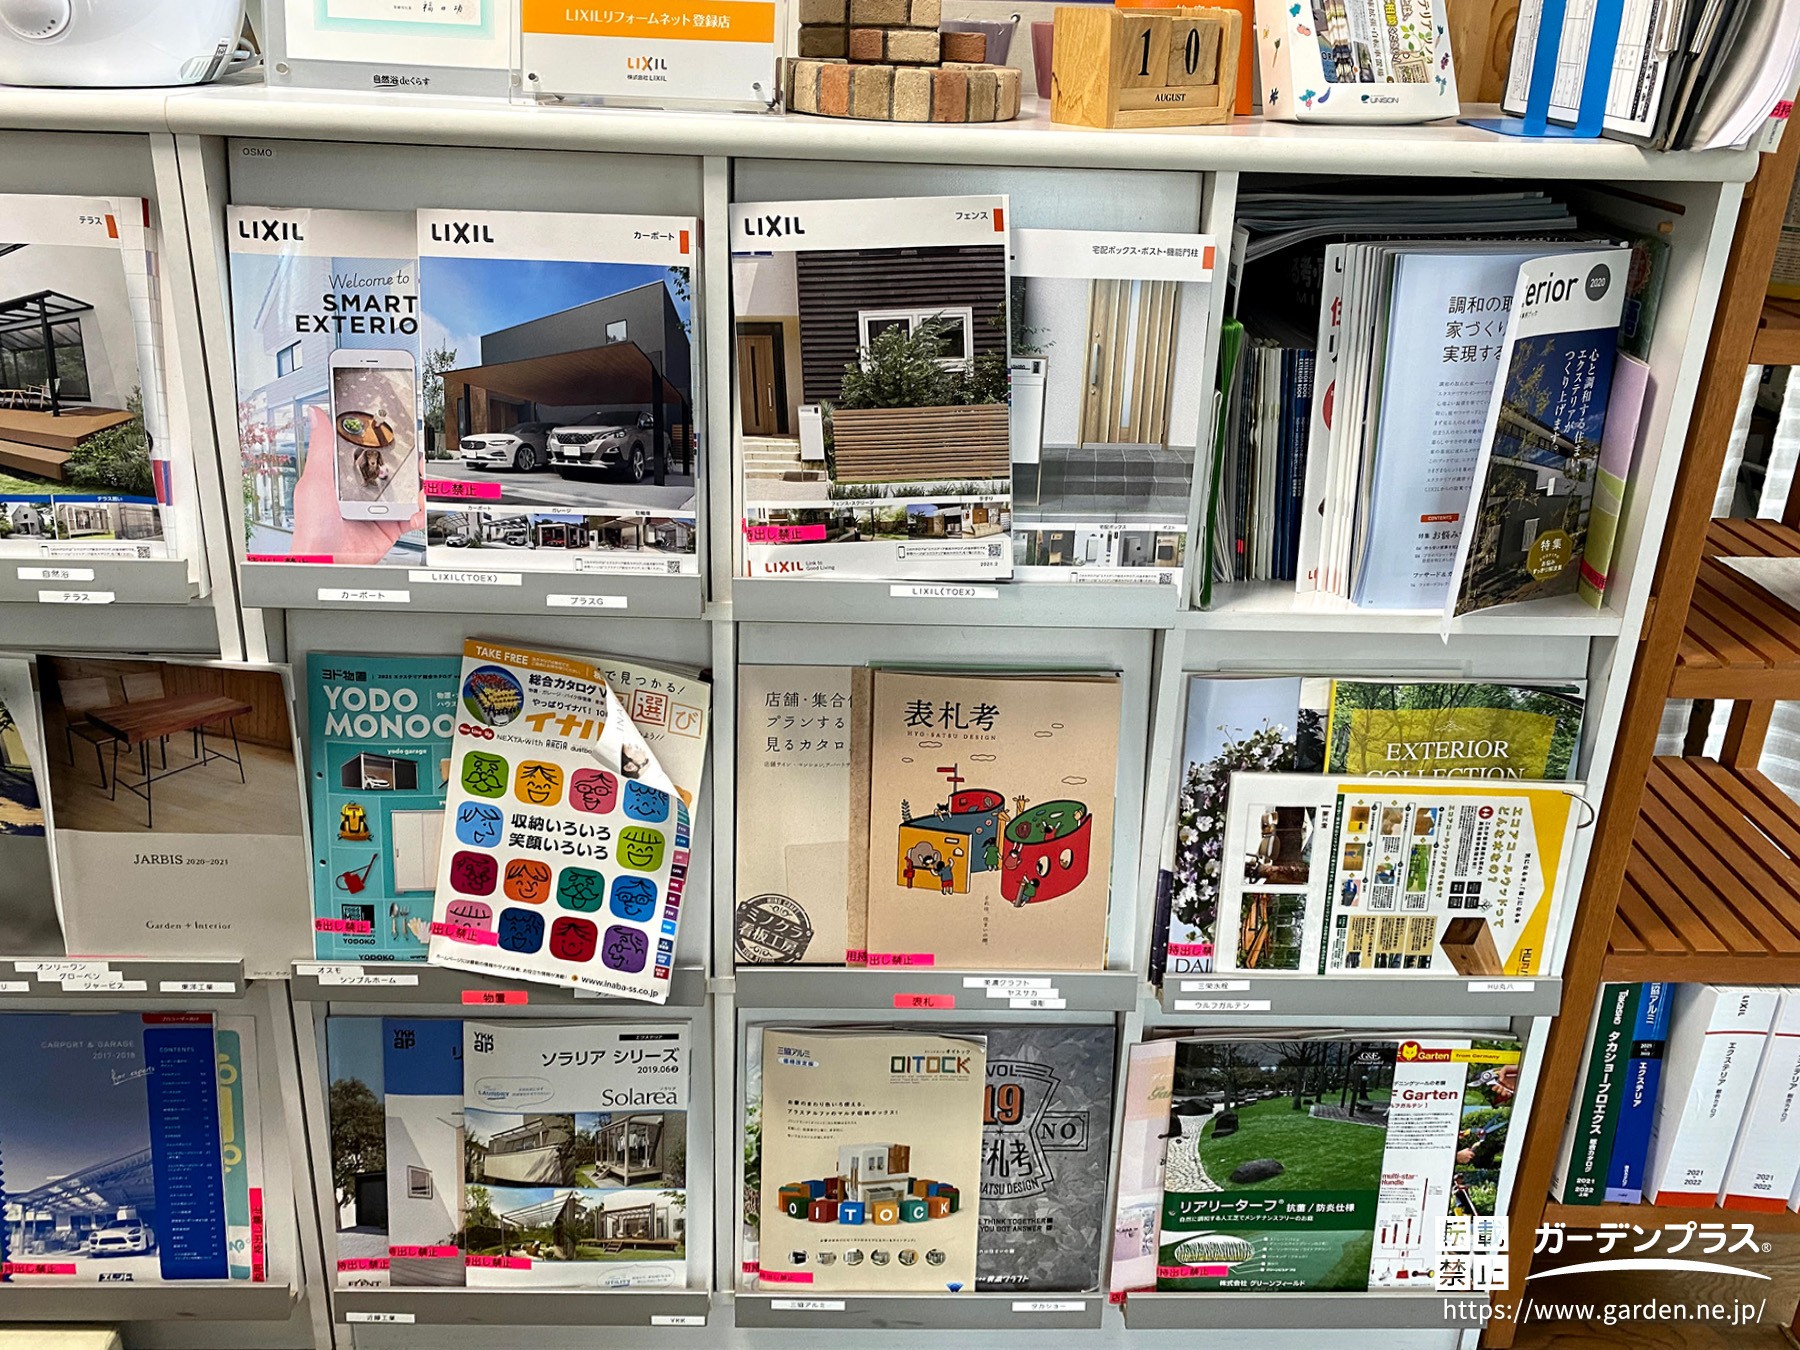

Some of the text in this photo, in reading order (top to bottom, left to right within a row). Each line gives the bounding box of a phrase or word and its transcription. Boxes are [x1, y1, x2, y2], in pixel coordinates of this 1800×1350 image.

[1137, 27, 1199, 77] 1 0
[627, 56, 667, 71] LIXIL
[1155, 93, 1186, 103] AUGUST
[242, 147, 273, 157] OSMO
[79, 216, 103, 226] テラス
[955, 210, 989, 221] フェンス
[238, 219, 304, 242] LIXIL
[431, 222, 495, 244] LIXIL
[744, 214, 806, 239] LIXIL
[633, 231, 675, 241] カーポート
[328, 270, 411, 290] Welcome to
[1589, 277, 1606, 288] 2020
[322, 294, 418, 314] SMART
[295, 314, 419, 335] EXTERIO
[1564, 350, 1587, 434] エクステリアが
[1540, 539, 1562, 551] 特集
[765, 561, 804, 574] LIXIL
[63, 593, 90, 602] テラス
[475, 644, 529, 665] TAKE FREE
[529, 673, 597, 695] 総合カタログ
[323, 685, 418, 713] YODO
[767, 715, 845, 729] プランする
[903, 699, 1000, 732] 表札考
[963, 733, 996, 741] DESIGN
[1386, 739, 1509, 761] EXTERIOR
[511, 813, 612, 842] 収納いろいろ
[508, 832, 609, 861] 笑顔いろいろ
[134, 854, 183, 865] JARBIS
[1494, 806, 1523, 929] エコアコールウッドって
[146, 920, 182, 930] Garden
[194, 921, 231, 930] Interior
[343, 937, 376, 945] YODOKO
[738, 920, 799, 954] 看板工房
[483, 992, 506, 1004] 物置
[912, 997, 935, 1007] 表札
[1738, 995, 1750, 1017] LIXIL
[393, 1029, 415, 1038] YKK
[473, 1032, 494, 1042] YKK
[41, 1041, 84, 1049] CARPORT
[97, 1040, 135, 1048] GARAGE
[393, 1037, 415, 1050] ap
[473, 1041, 494, 1053] ap
[541, 1047, 680, 1067] ソラリア シリーズ
[1417, 1051, 1450, 1060] Garten
[890, 1056, 971, 1074] OITOCK
[1717, 1041, 1737, 1086] エクステリア
[1589, 1031, 1621, 1135] タカショープロエクス
[1633, 1062, 1648, 1108] エクステリア
[602, 1088, 678, 1107] Solarea
[1402, 1088, 1459, 1101] Garten
[1041, 1123, 1077, 1140] NO
[982, 1138, 1033, 1178] 札考
[1756, 1173, 1774, 1181] 2021
[1006, 1177, 1040, 1195] DESIGN
[984, 1217, 1046, 1226] THINK TOGETHER
[1012, 1224, 1043, 1233] ANSWER
[1250, 1279, 1306, 1288] グリーンフィールド
